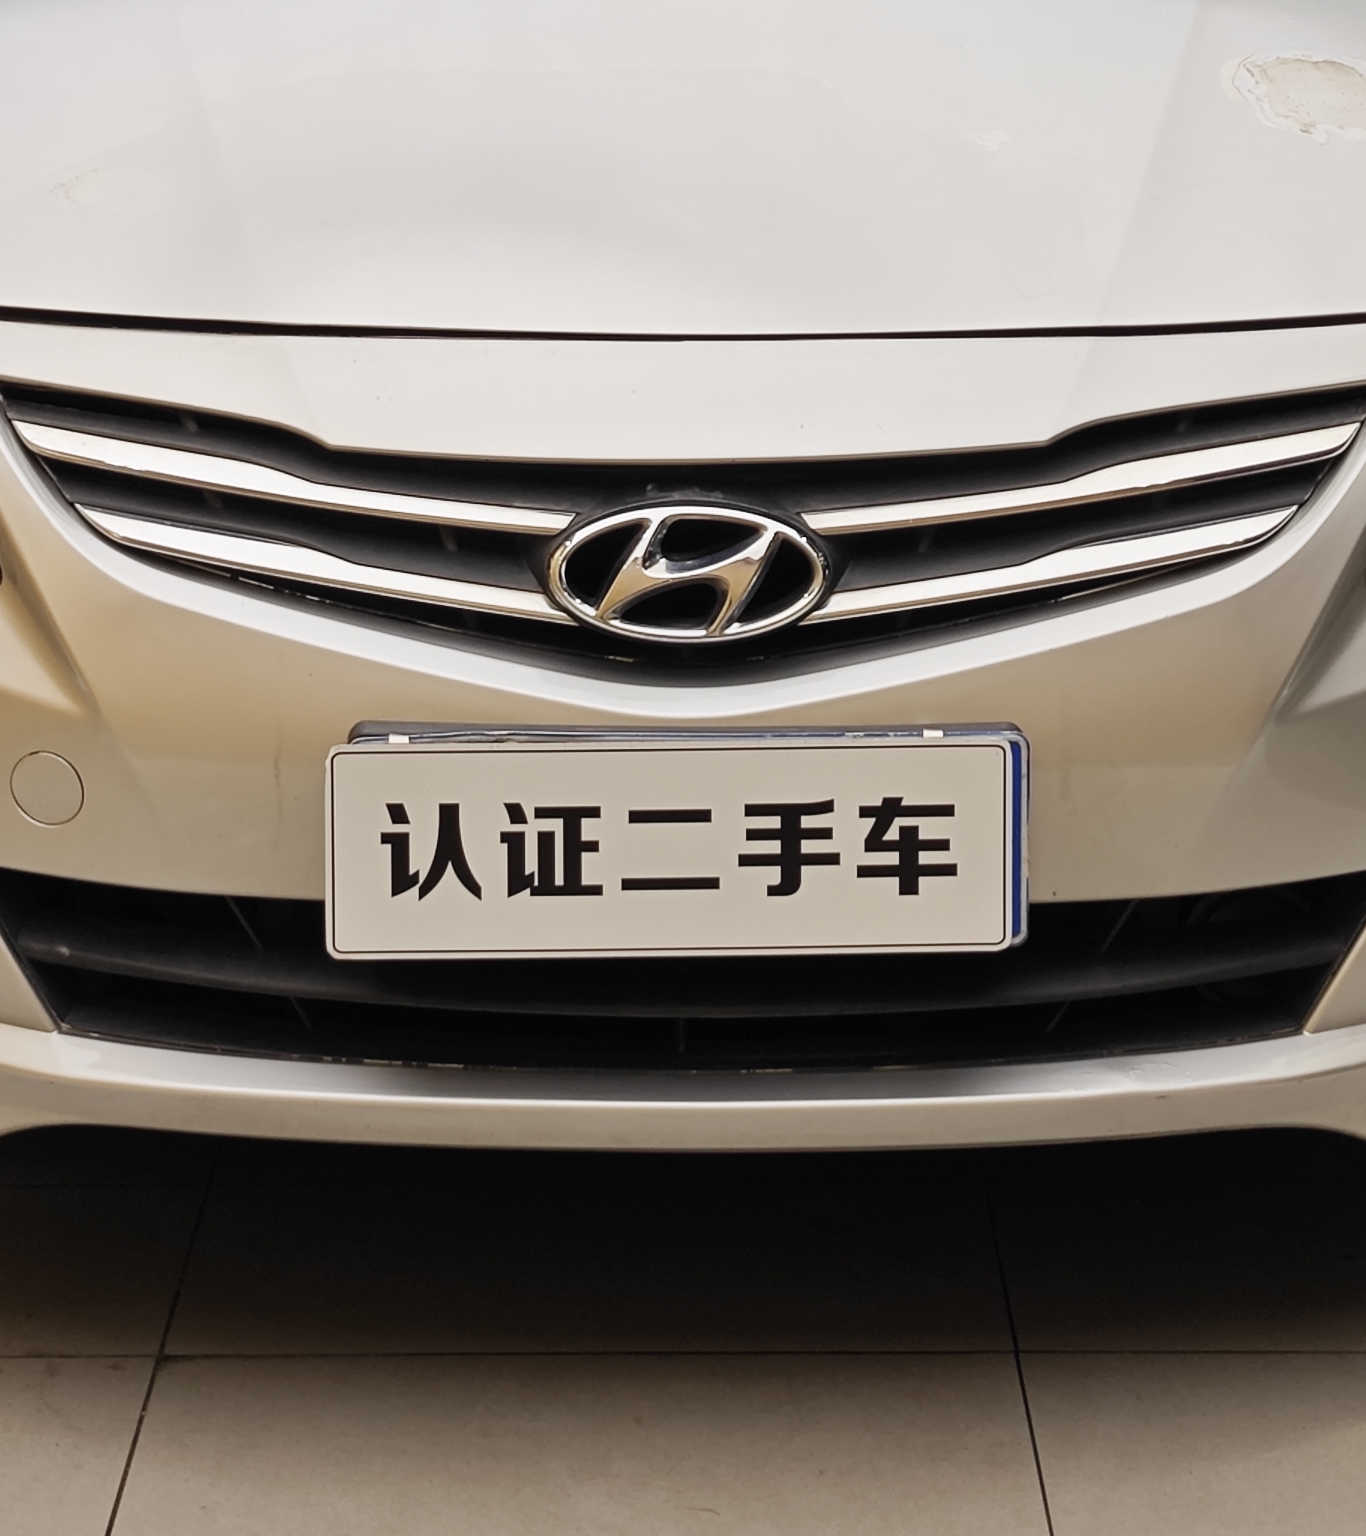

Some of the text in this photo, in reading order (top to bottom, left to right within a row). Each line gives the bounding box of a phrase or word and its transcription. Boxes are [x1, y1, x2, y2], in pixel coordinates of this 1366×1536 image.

[379, 796, 958, 902] 认证二手车
